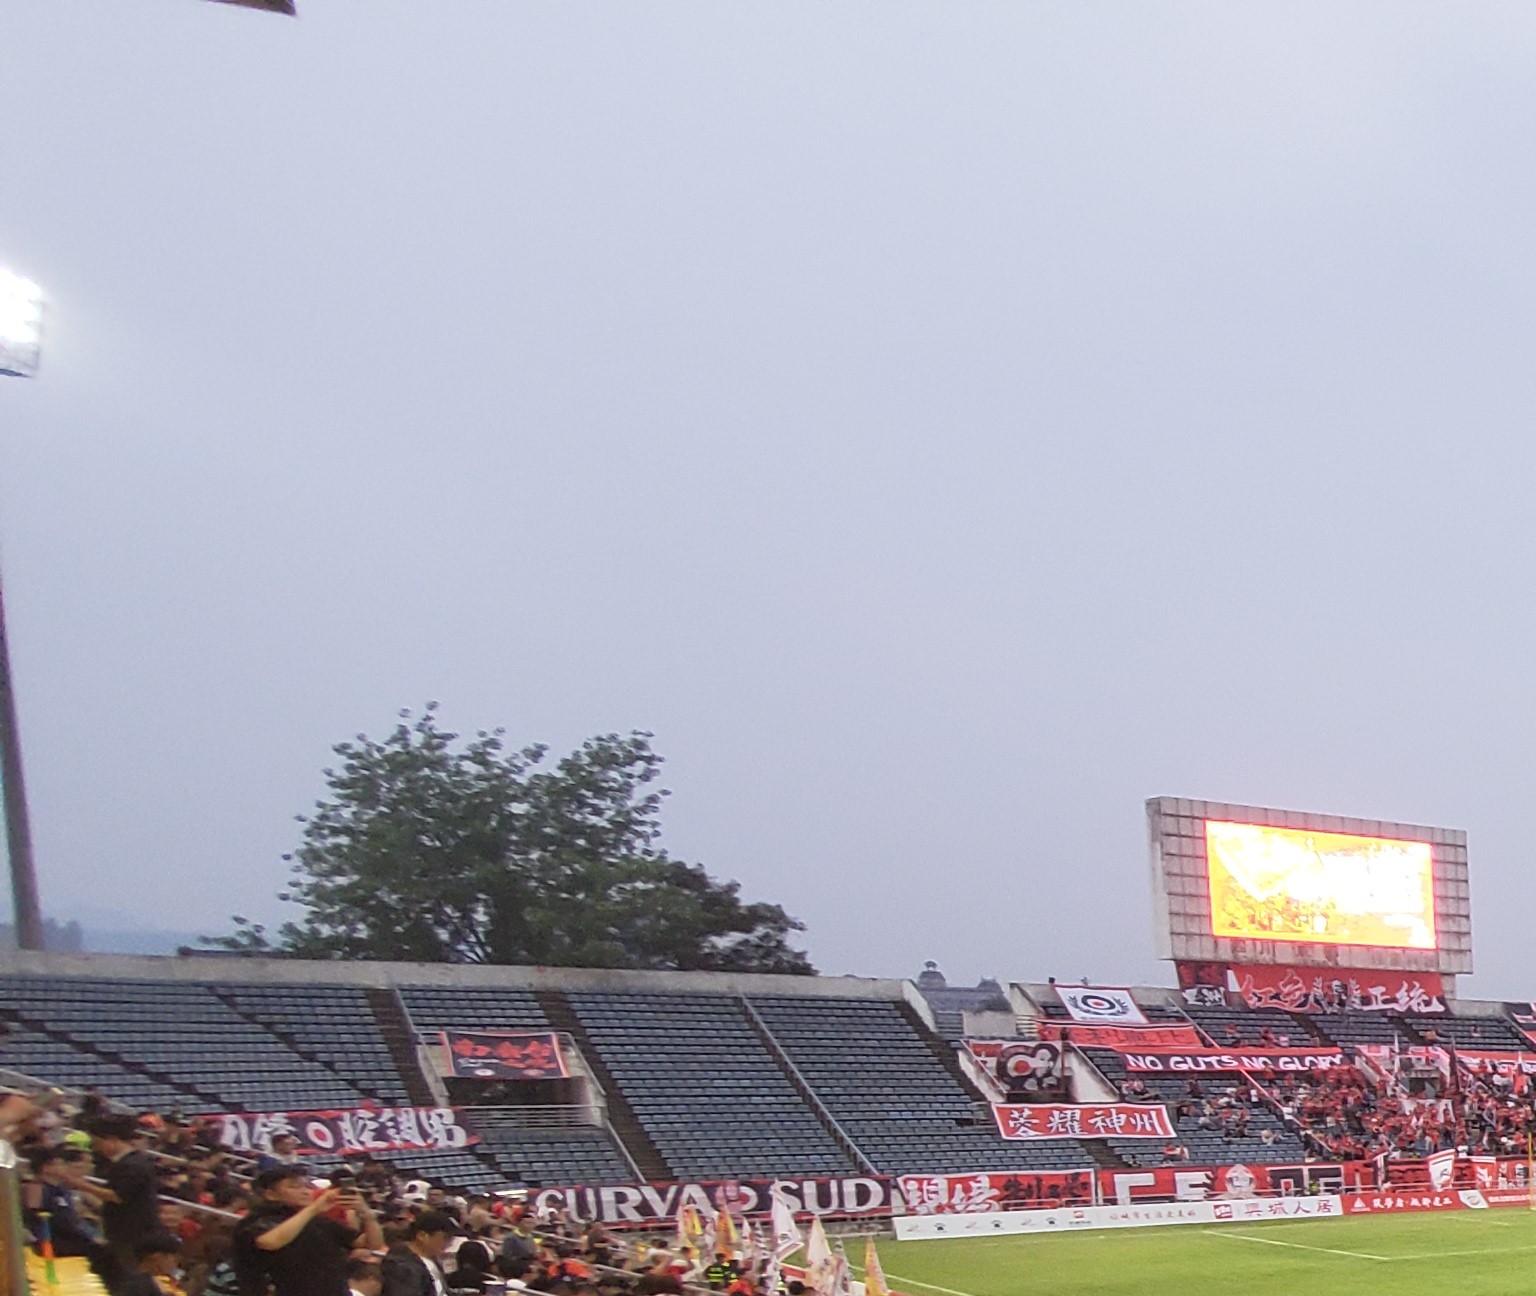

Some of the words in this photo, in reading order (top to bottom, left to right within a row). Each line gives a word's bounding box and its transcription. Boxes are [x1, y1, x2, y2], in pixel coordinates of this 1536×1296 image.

[1125, 1053, 1163, 1070] NO
[1169, 1055, 1238, 1071] GUTS
[1242, 1056, 1272, 1070] NO
[1279, 1053, 1343, 1071] GLORY
[1008, 1108, 1165, 1137] 荣耀神州
[535, 1183, 717, 1225] CURVA
[769, 1177, 885, 1216] SUD
